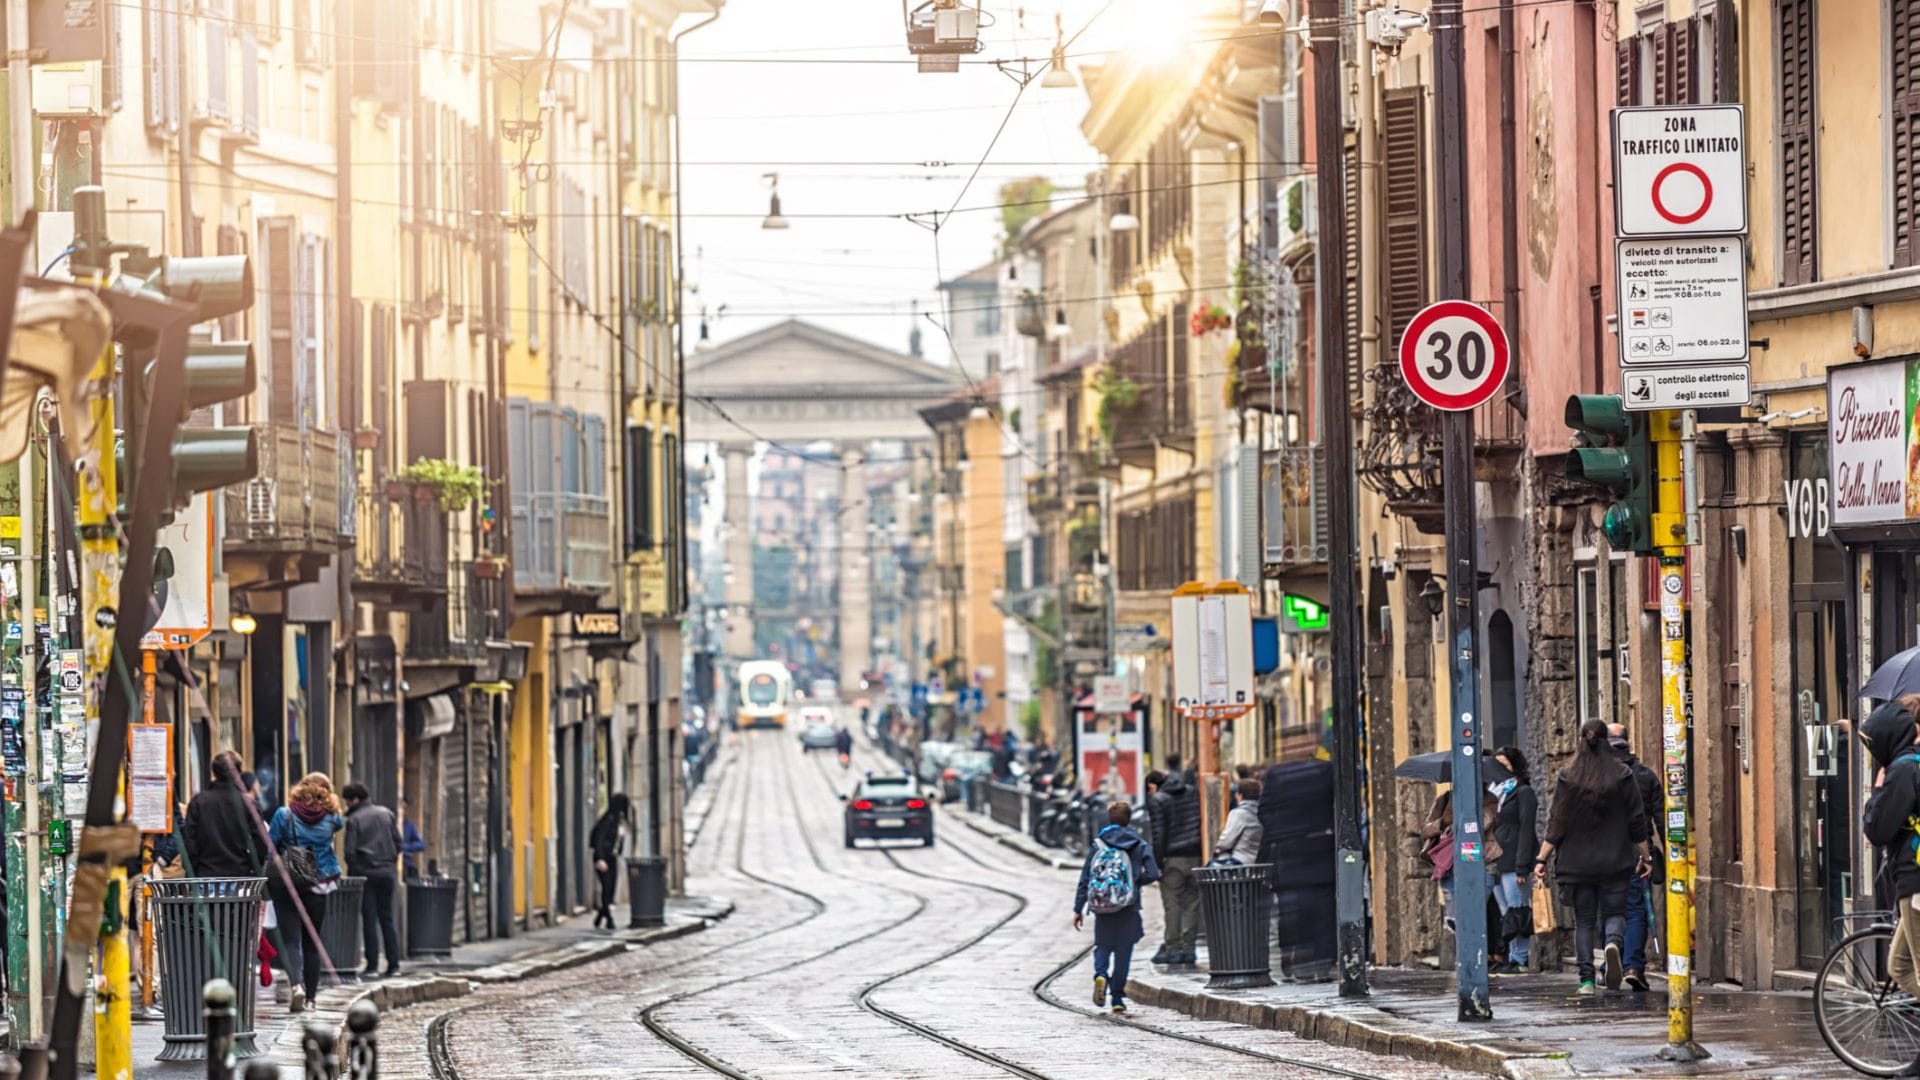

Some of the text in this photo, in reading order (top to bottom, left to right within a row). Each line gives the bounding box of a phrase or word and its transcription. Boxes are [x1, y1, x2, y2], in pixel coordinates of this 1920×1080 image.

[1664, 117, 1697, 133] ZONA
[1623, 137, 1739, 155] TRAFFICO LIMITATO
[1625, 245, 1729, 257] divieto di transito a:
[1631, 259, 1657, 267] veicoli
[1676, 257, 1718, 265] autorizzati
[1626, 269, 1668, 278] eccetto:
[1426, 330, 1486, 380] 30
[1657, 372, 1746, 384] controllo elettronico
[1675, 389, 1730, 401] degli accessi
[1836, 387, 1901, 444] Pizzeria
[1837, 459, 1901, 509] Della Nonna
[1784, 478, 1830, 538] YOB
